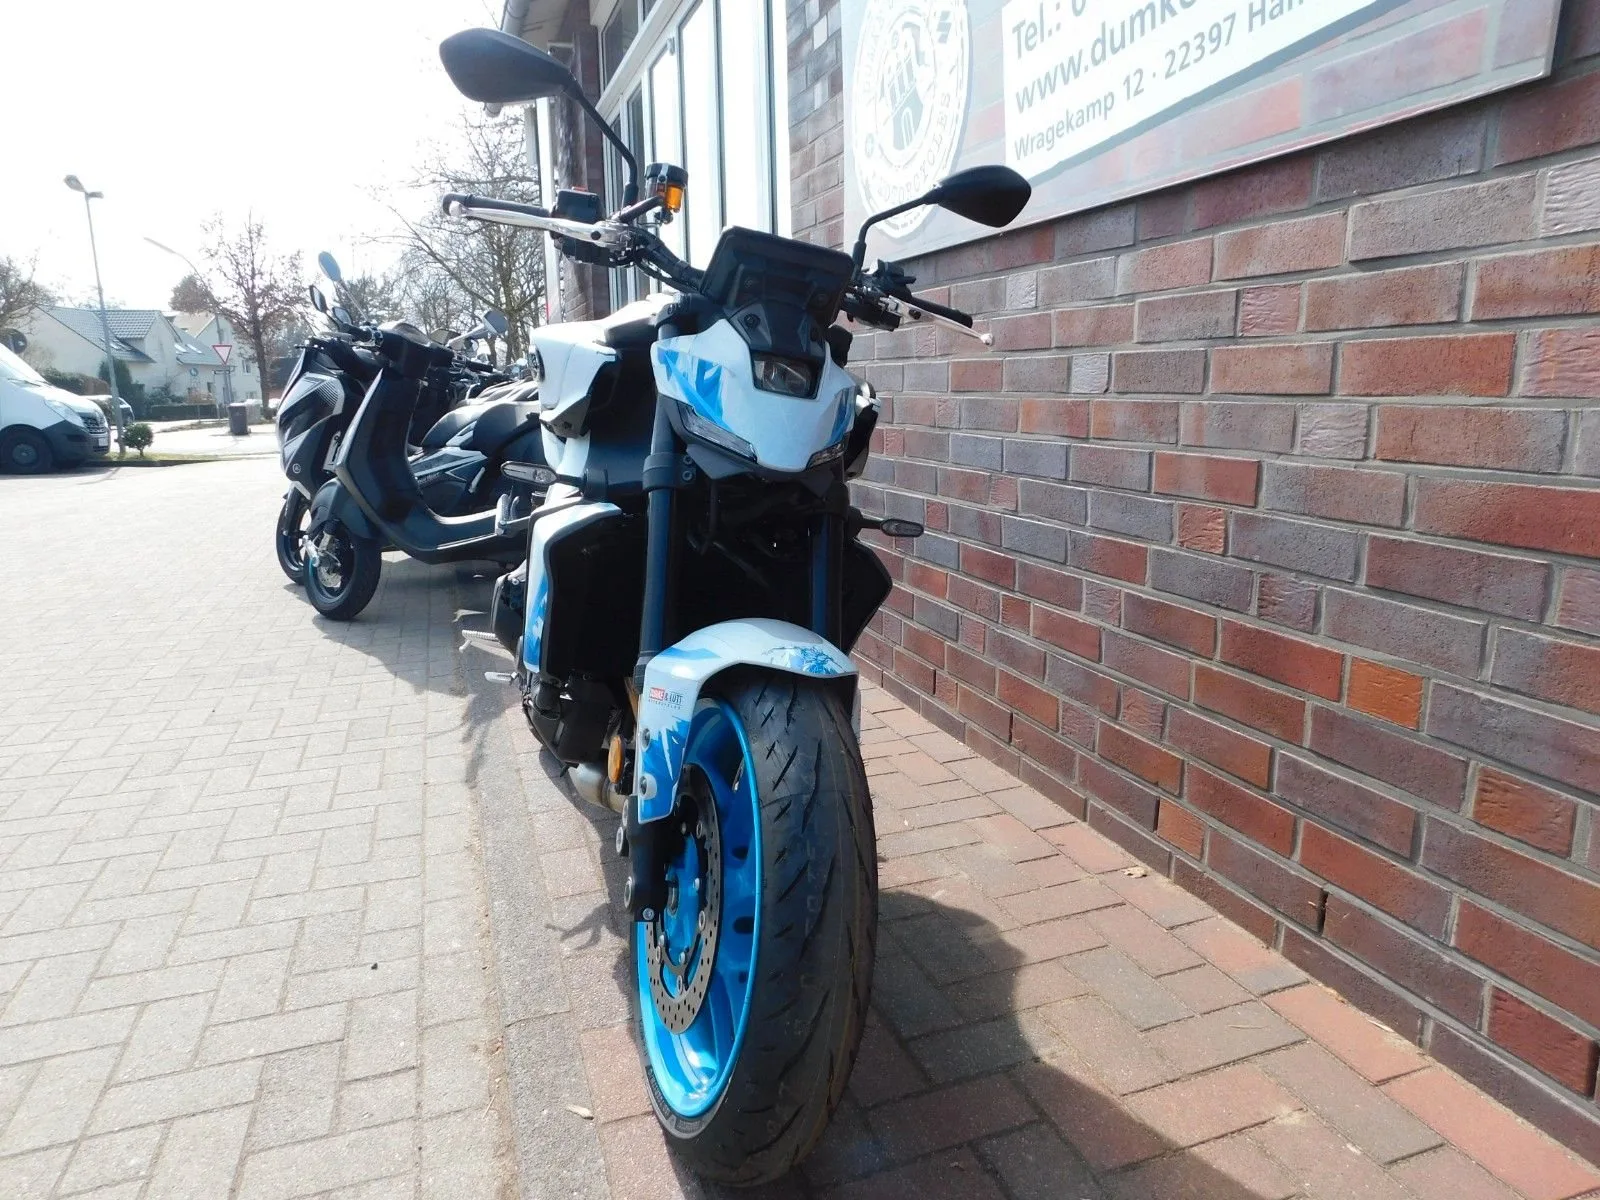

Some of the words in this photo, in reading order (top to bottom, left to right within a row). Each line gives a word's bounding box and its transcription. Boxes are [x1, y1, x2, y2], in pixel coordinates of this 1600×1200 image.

[1012, 0, 1061, 60] Tel.:
[1014, 91, 1115, 161] Wragekamp
[1123, 67, 1145, 101] 12
[1164, 12, 1236, 80] 22397
[1015, 0, 1197, 114] www.dumk
